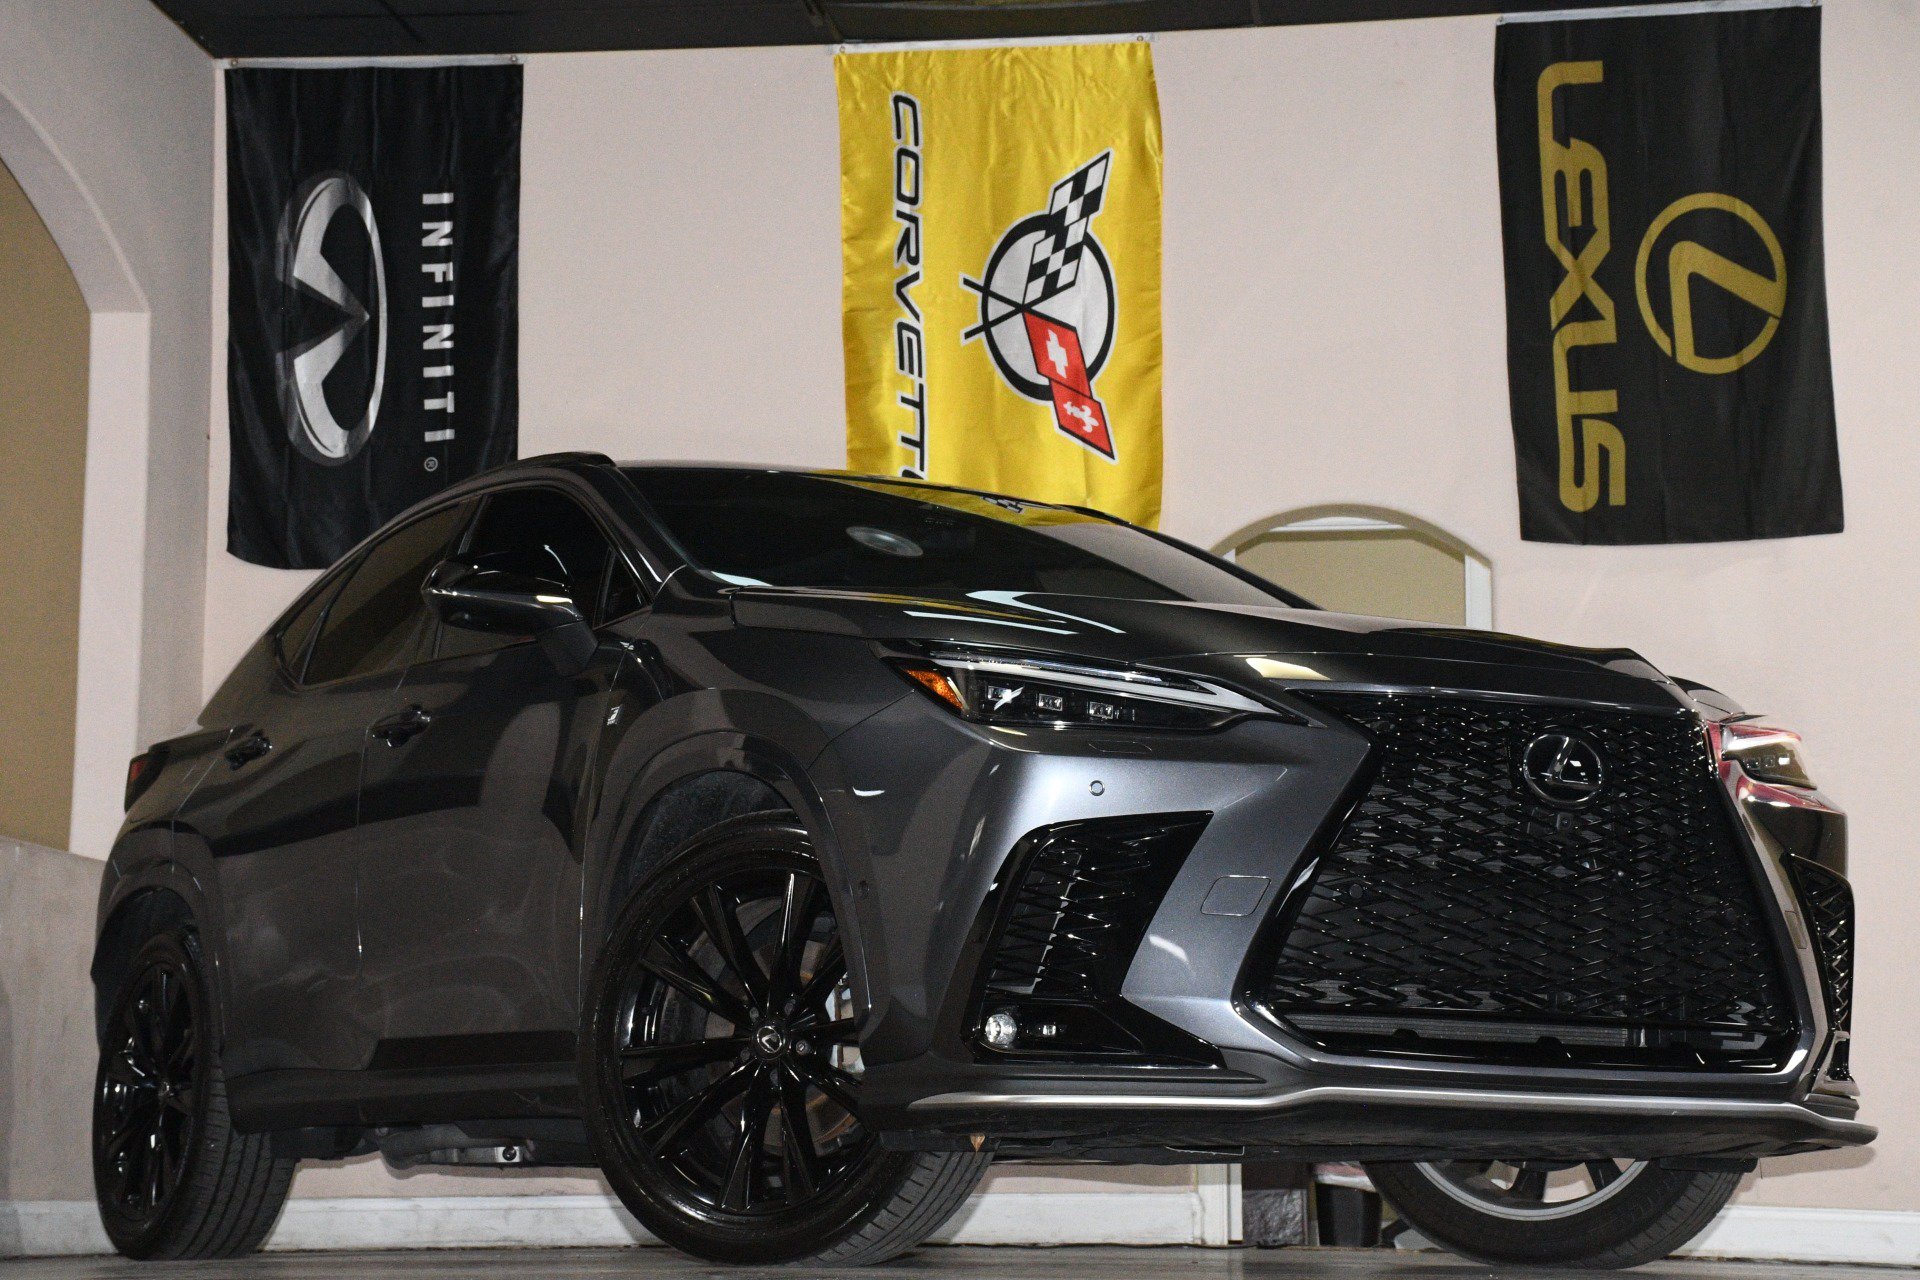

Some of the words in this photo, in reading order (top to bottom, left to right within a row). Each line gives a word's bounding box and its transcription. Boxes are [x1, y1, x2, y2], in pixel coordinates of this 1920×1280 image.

[421, 192, 455, 442] INFINITI
[891, 93, 928, 479] CORVETT
[1537, 61, 1626, 512] LEXUS
